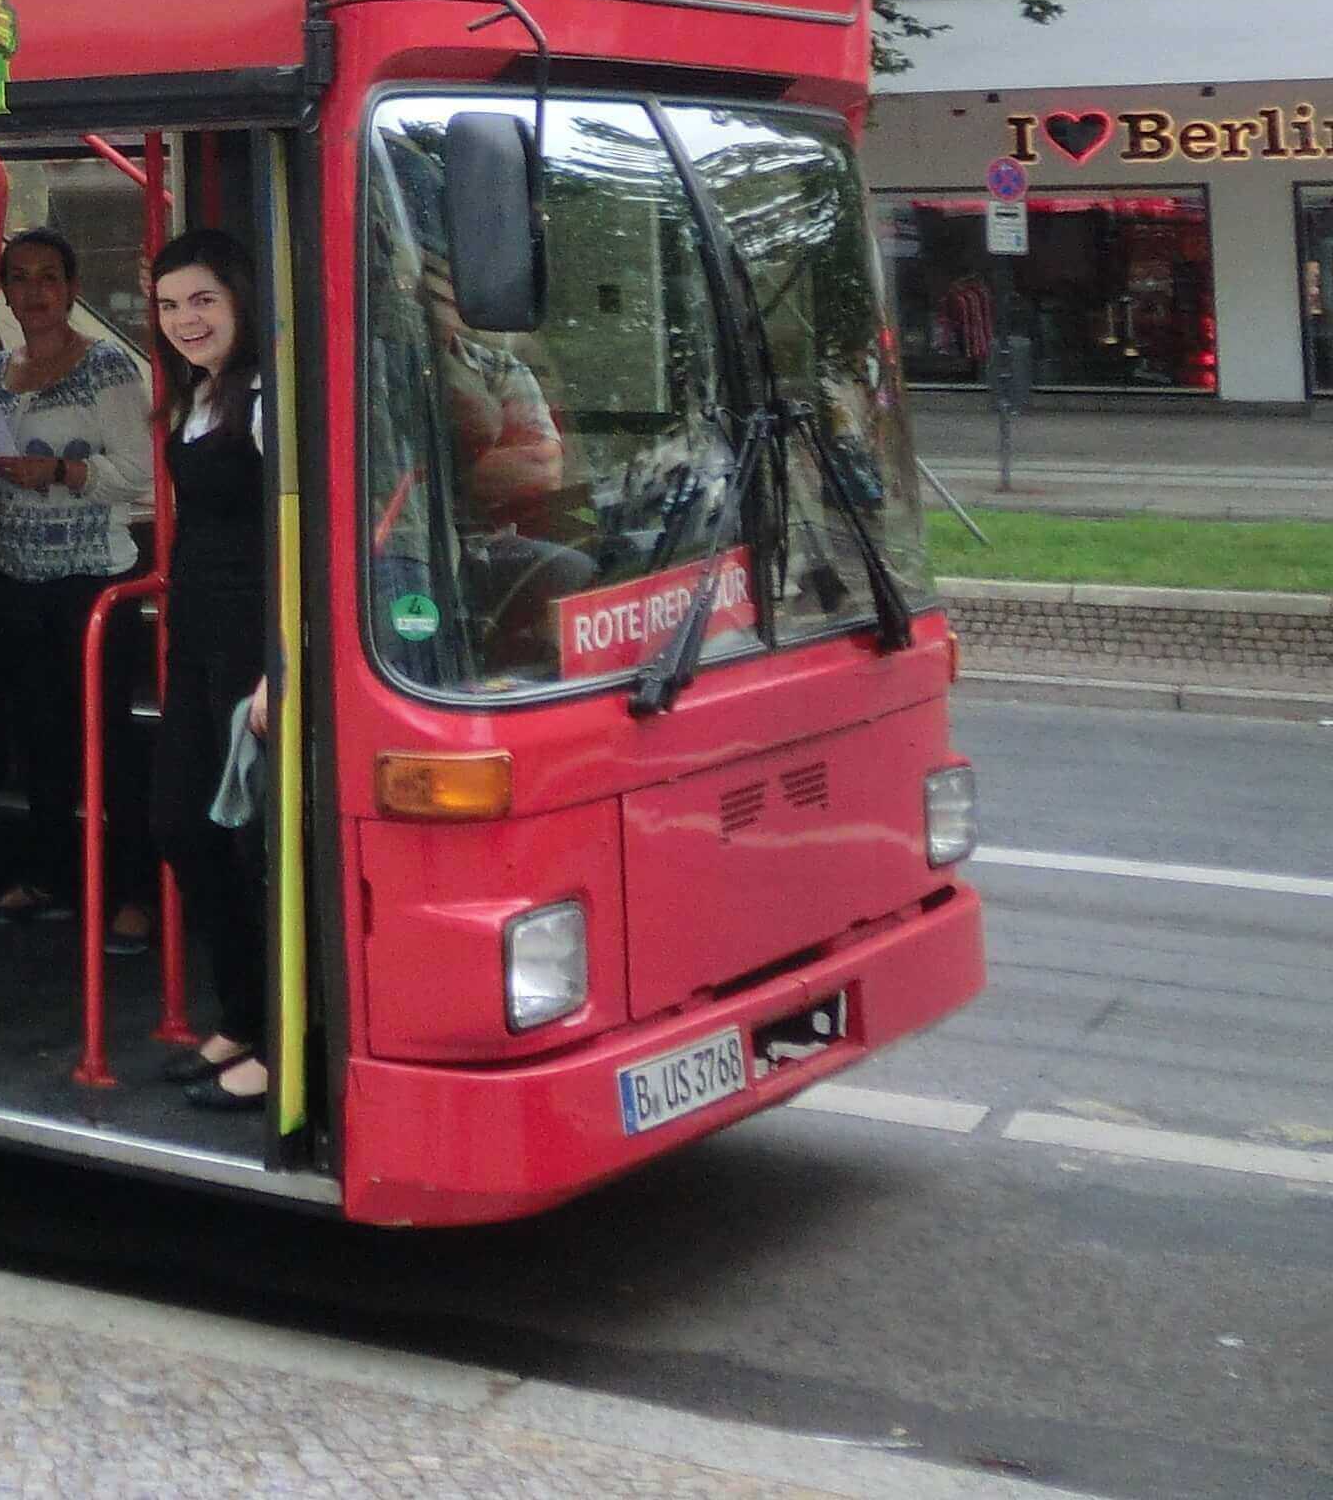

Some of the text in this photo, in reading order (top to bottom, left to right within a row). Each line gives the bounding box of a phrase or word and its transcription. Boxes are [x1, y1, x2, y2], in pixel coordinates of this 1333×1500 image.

[1006, 102, 1333, 163] I Berli
[635, 1037, 742, 1120] B US 3768
